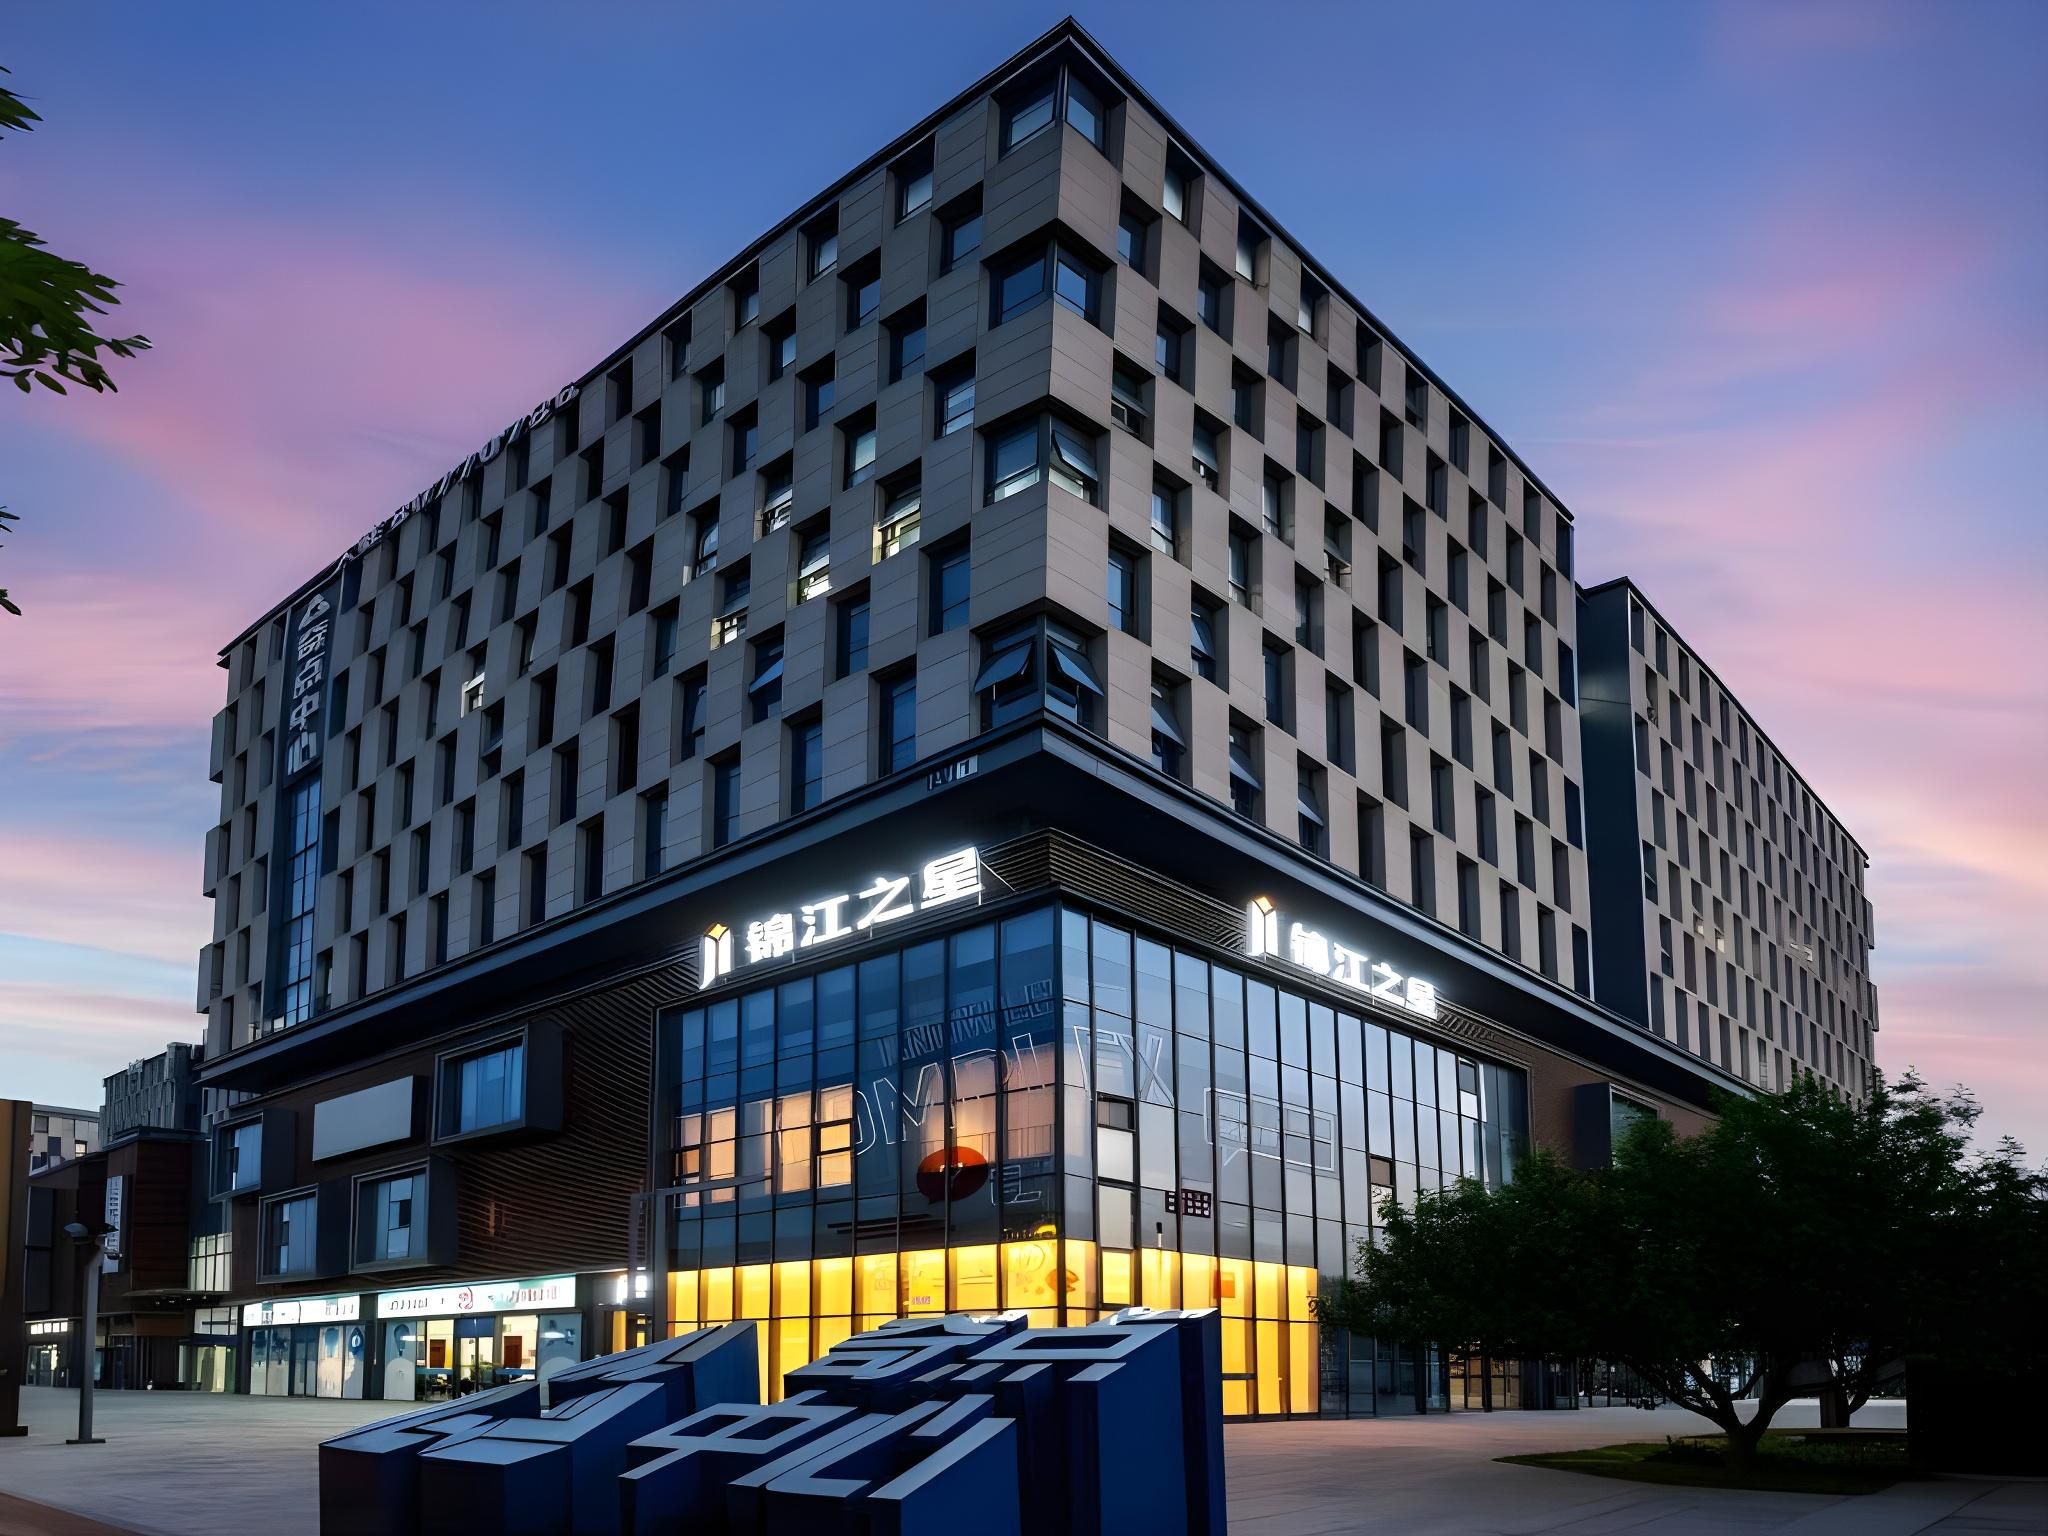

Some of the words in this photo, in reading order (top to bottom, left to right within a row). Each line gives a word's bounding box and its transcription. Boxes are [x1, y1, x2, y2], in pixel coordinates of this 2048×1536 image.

[746, 847, 983, 963] 锦江之星
[784, 1307, 1219, 1383] 奇点
[620, 1390, 1017, 1500] 中心
